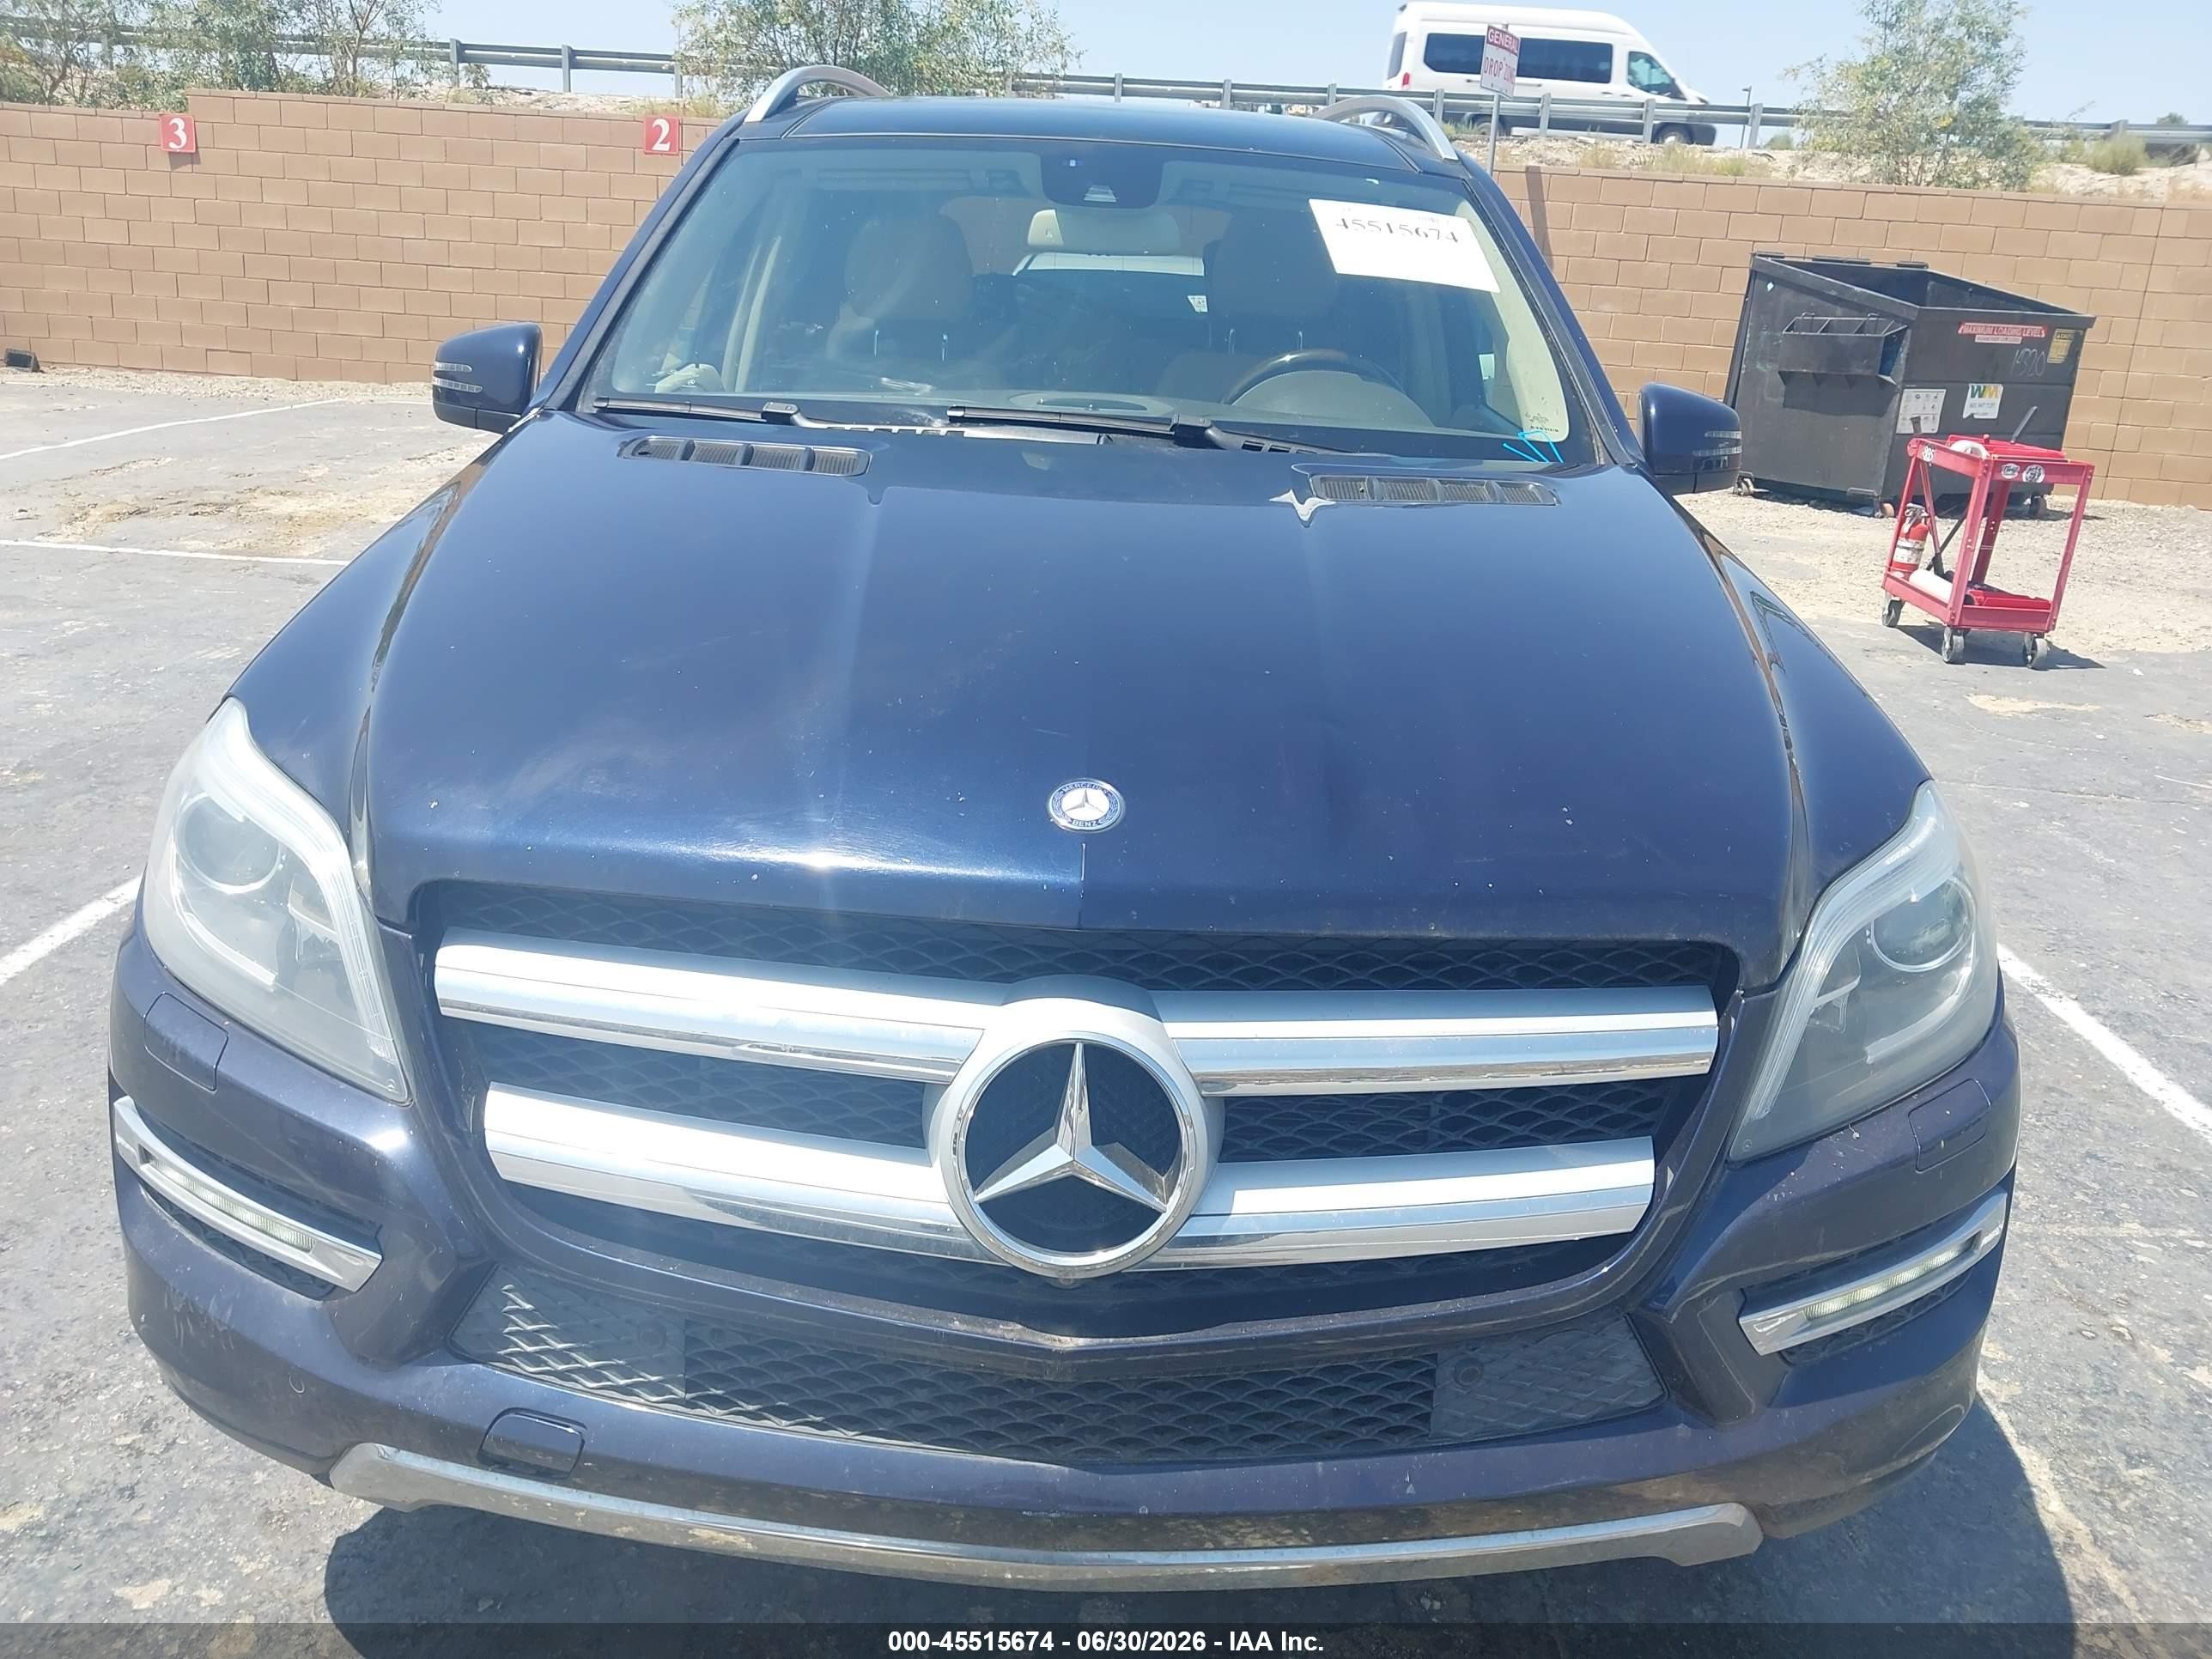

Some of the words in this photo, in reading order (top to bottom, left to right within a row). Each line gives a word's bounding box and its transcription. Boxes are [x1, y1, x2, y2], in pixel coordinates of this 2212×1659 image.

[1484, 57, 1504, 78] DROP
[168, 117, 188, 149] 3
[652, 118, 671, 152] 2
[1336, 217, 1459, 243] 45515674
[1994, 326, 2021, 337] LOADING
[1970, 384, 2000, 399] WM
